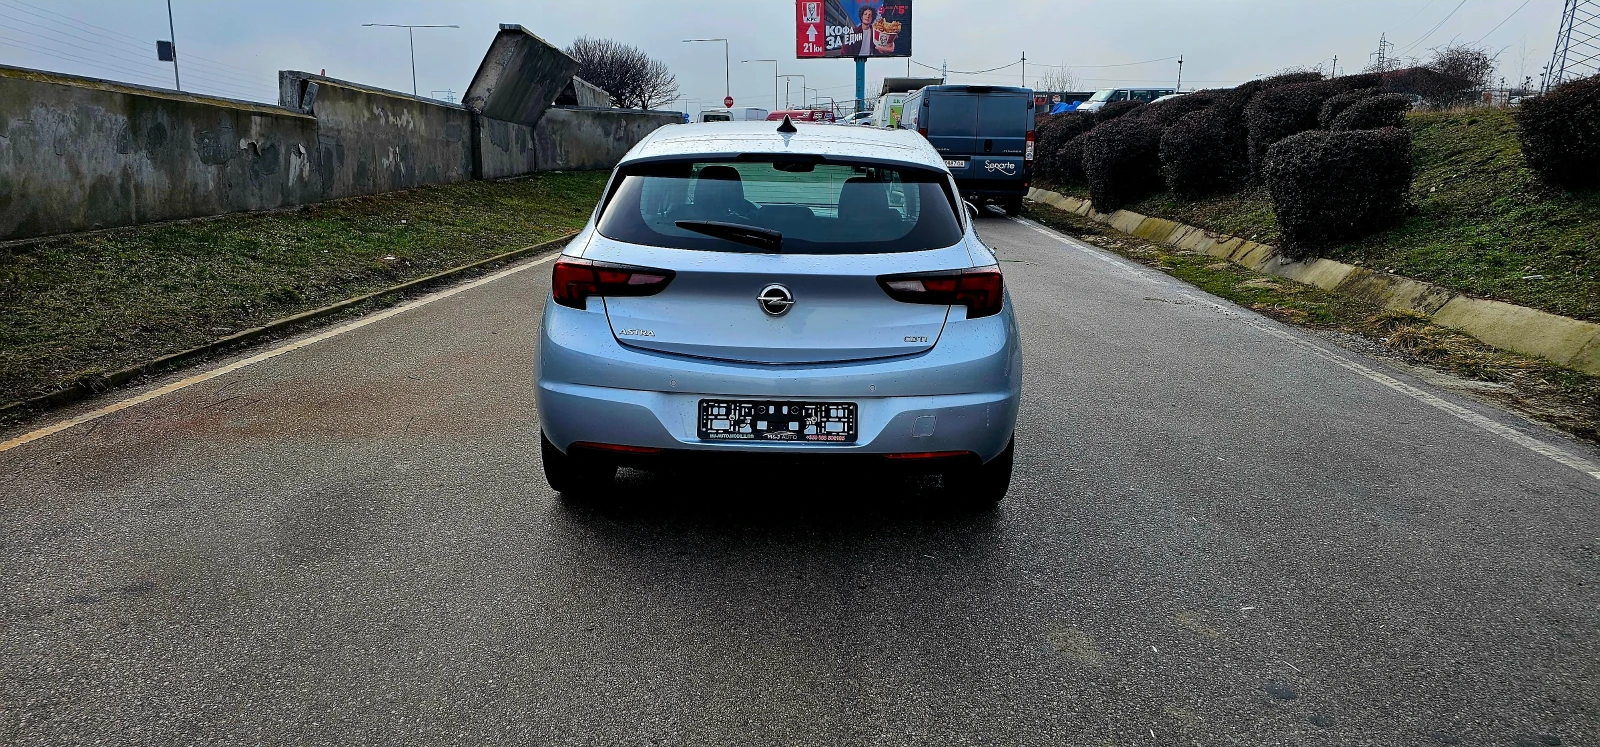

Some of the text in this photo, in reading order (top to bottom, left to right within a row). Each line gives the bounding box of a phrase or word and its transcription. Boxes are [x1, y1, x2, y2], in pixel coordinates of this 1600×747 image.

[825, 26, 854, 37] КОФА
[826, 33, 862, 49] ЗА ЕДИН
[803, 43, 812, 52] 21
[619, 328, 656, 337] ASTRA
